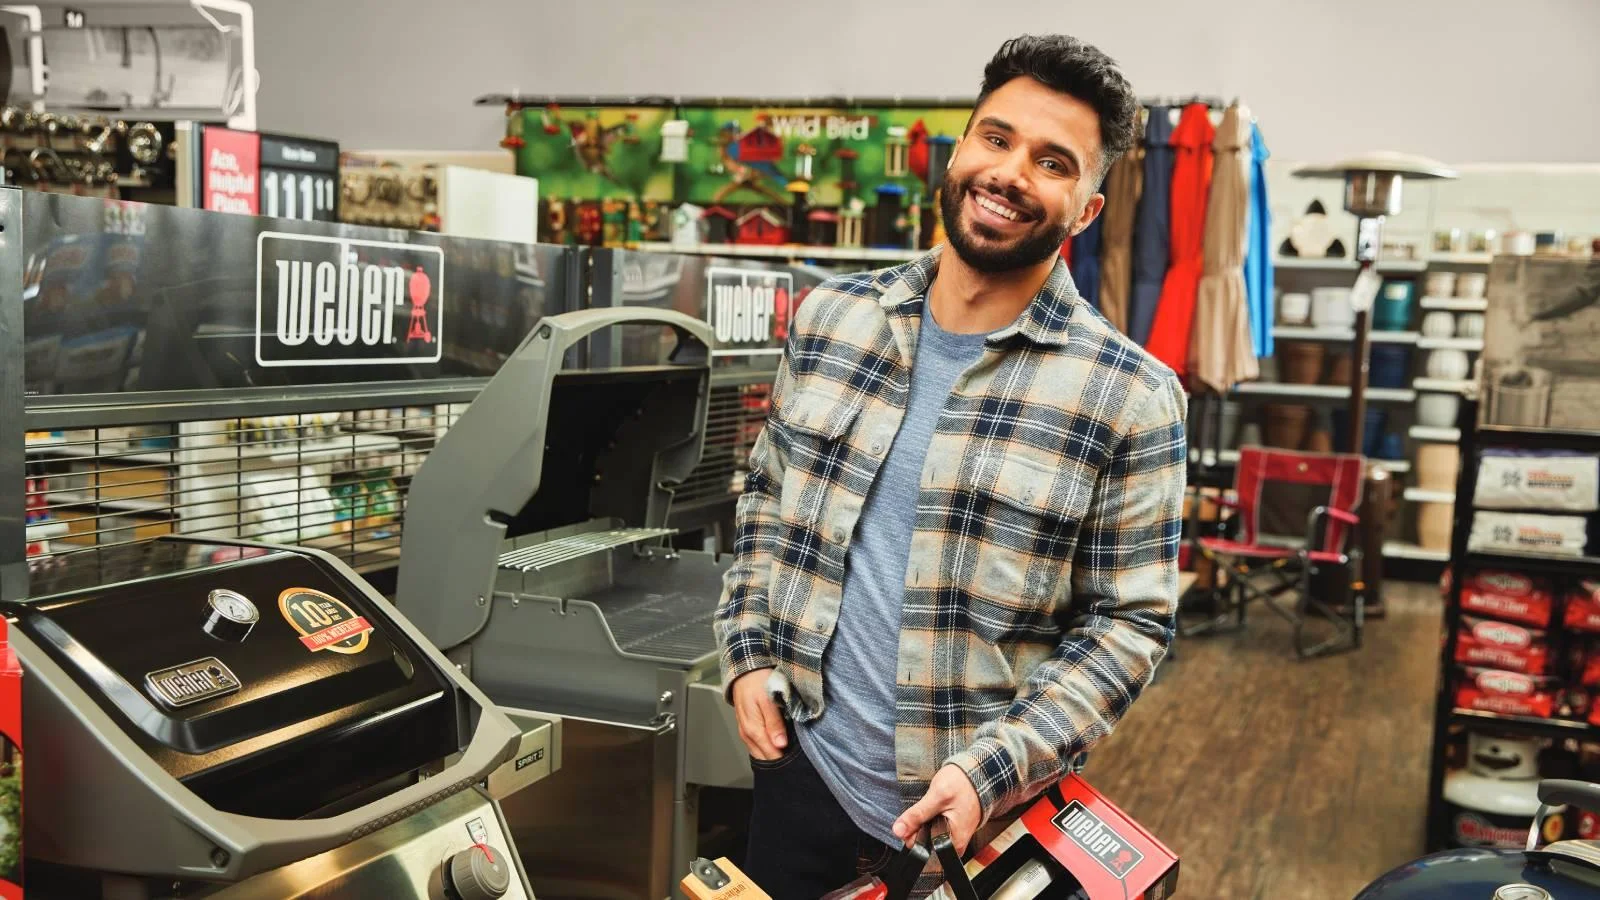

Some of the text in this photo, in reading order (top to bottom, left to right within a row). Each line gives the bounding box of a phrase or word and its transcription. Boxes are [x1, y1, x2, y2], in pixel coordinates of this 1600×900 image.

[771, 114, 870, 141] Wild Bird
[275, 243, 405, 346] weber
[714, 273, 775, 343] weber
[290, 600, 333, 628] 10
[1061, 806, 1121, 858] weber
